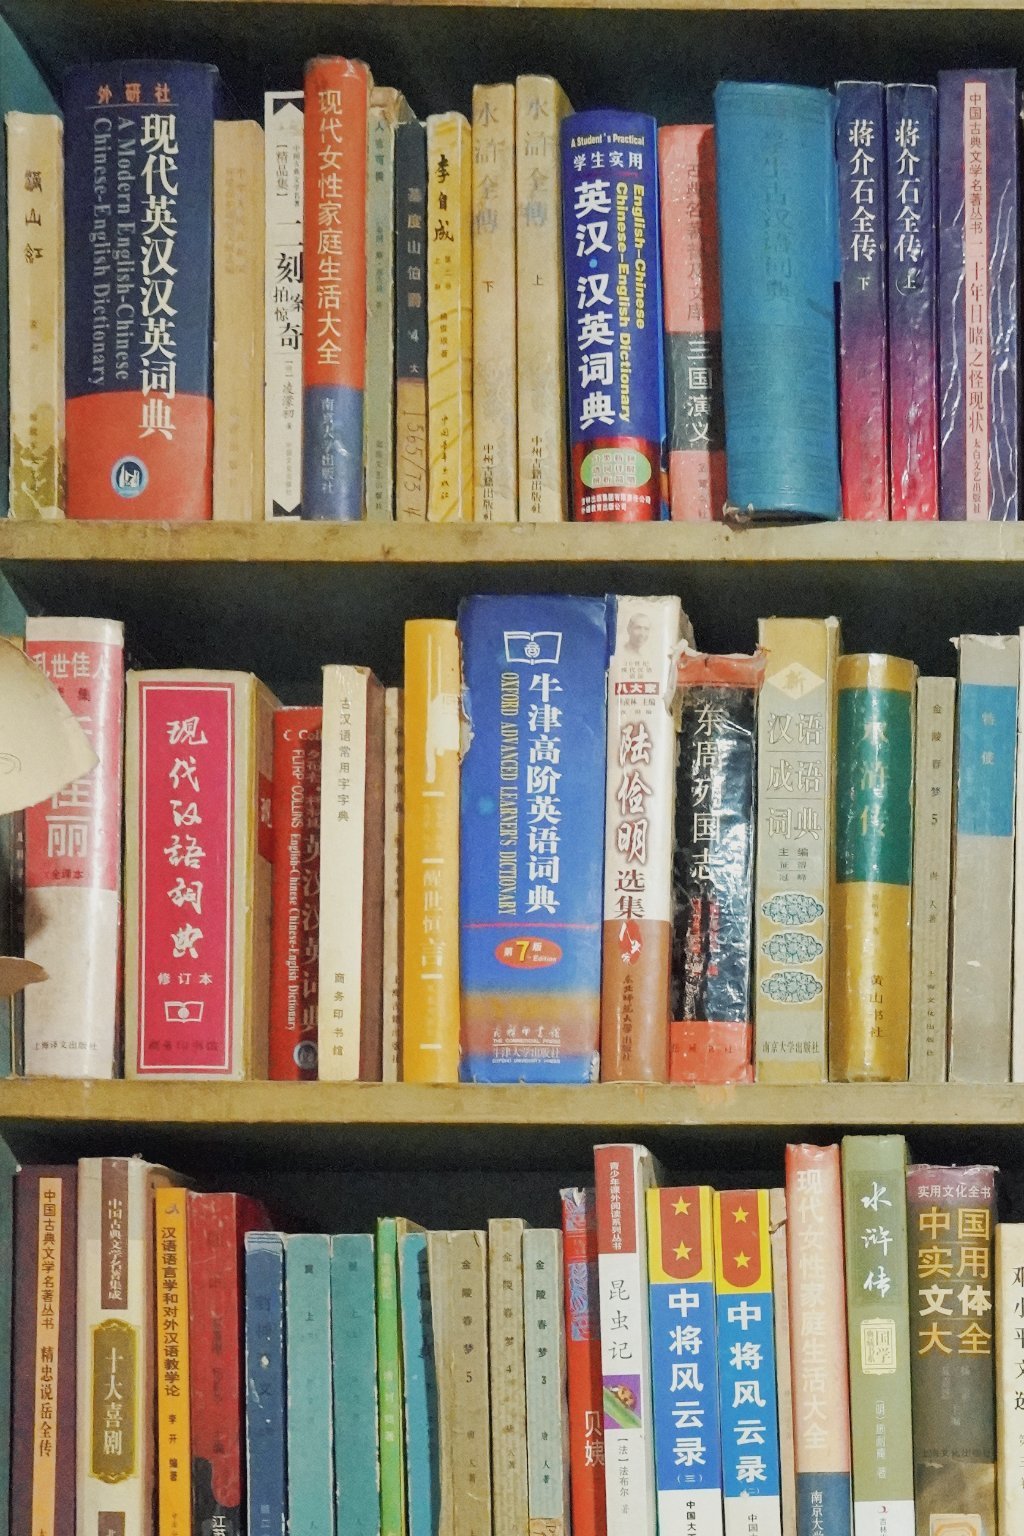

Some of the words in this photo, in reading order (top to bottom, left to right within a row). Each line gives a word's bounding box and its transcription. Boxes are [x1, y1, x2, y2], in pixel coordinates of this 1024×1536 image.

[97, 83, 171, 104] 外研社
[118, 116, 136, 131] A
[117, 138, 136, 214] Modern
[573, 151, 644, 171] 学生实用
[612, 133, 646, 147] Practical
[969, 93, 983, 234] 中国古典文学名著丛书
[89, 117, 112, 276] Chinese-English
[317, 89, 344, 366] 现代女性家庭生活大全
[434, 154, 455, 243] 李自成
[849, 119, 876, 262] 蒋介石全传
[895, 118, 921, 263] 蒋介石全传
[111, 222, 136, 380] English-Chinese
[138, 113, 179, 441] 现代英汉汉英词典
[859, 277, 870, 292] 下
[88, 283, 111, 387] Dictionary
[618, 332, 631, 423] Dictionary
[686, 339, 713, 441] 三国演义
[972, 438, 982, 514] 太白文艺出版社
[501, 672, 519, 716] OXFORD
[616, 682, 657, 694] 八大家
[338, 697, 352, 824] 古汉语常用字字典
[500, 721, 519, 781] ADVANCED
[766, 712, 825, 746] 汉语
[500, 785, 519, 846] LEARNER'S
[525, 672, 564, 915] 牛津高阶英语词典
[691, 703, 725, 881] 东周列国志
[765, 758, 824, 793] 成语
[765, 806, 823, 841] 词典
[778, 847, 809, 857] 主编
[498, 851, 517, 915] DICTIONARY
[157, 971, 213, 985] 修订本
[333, 972, 346, 1057] 商务印书馆
[761, 1043, 820, 1054] 南京大学出版社
[609, 1161, 623, 1249] 青少年课外阅读系列丛书
[917, 1184, 991, 1198] 实用文化全书
[918, 1207, 991, 1241] 中国
[40, 1188, 56, 1330] 中国古典文学名著丛书
[917, 1246, 990, 1277] 实用
[161, 1227, 181, 1398] 汉语语言学和对外汉语教学论
[535, 1259, 548, 1358] 金陵春梦
[607, 1279, 633, 1360] 昆虫记
[797, 1169, 827, 1450] 现代女性家庭生活大全
[918, 1284, 992, 1317] 文体
[918, 1323, 992, 1355] 大全
[38, 1345, 54, 1458] 精忠说岳全传
[103, 1348, 123, 1457] 十大喜剧
[465, 1371, 473, 1383] 5
[668, 1288, 707, 1467] 中将风云录
[727, 1301, 768, 1483] 中将风云录
